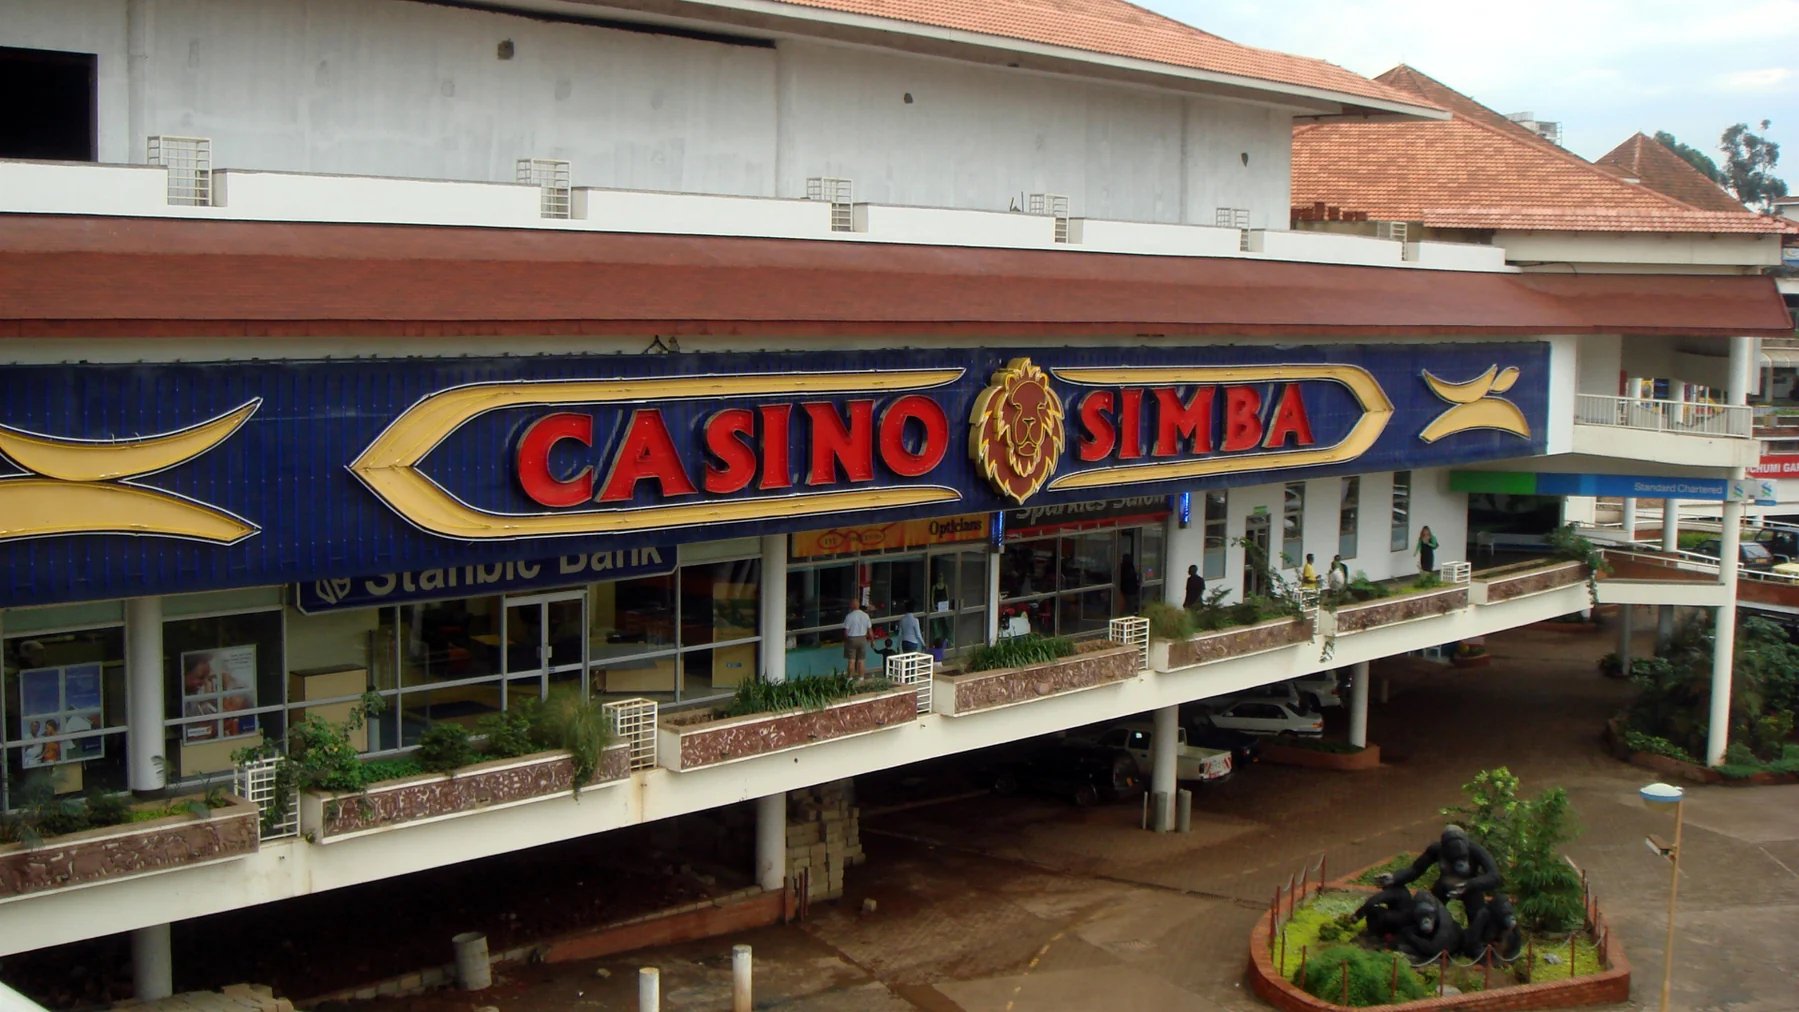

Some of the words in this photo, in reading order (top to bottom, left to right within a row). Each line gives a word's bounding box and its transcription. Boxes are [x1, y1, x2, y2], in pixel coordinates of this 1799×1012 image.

[517, 395, 949, 507] CASINO
[1079, 383, 1315, 461] SIMBA
[1634, 482, 1676, 493] Standard
[1677, 484, 1724, 495] Chartered
[928, 518, 982, 538] Opticians
[365, 558, 541, 596] Stanbic
[559, 546, 663, 575] Bank
